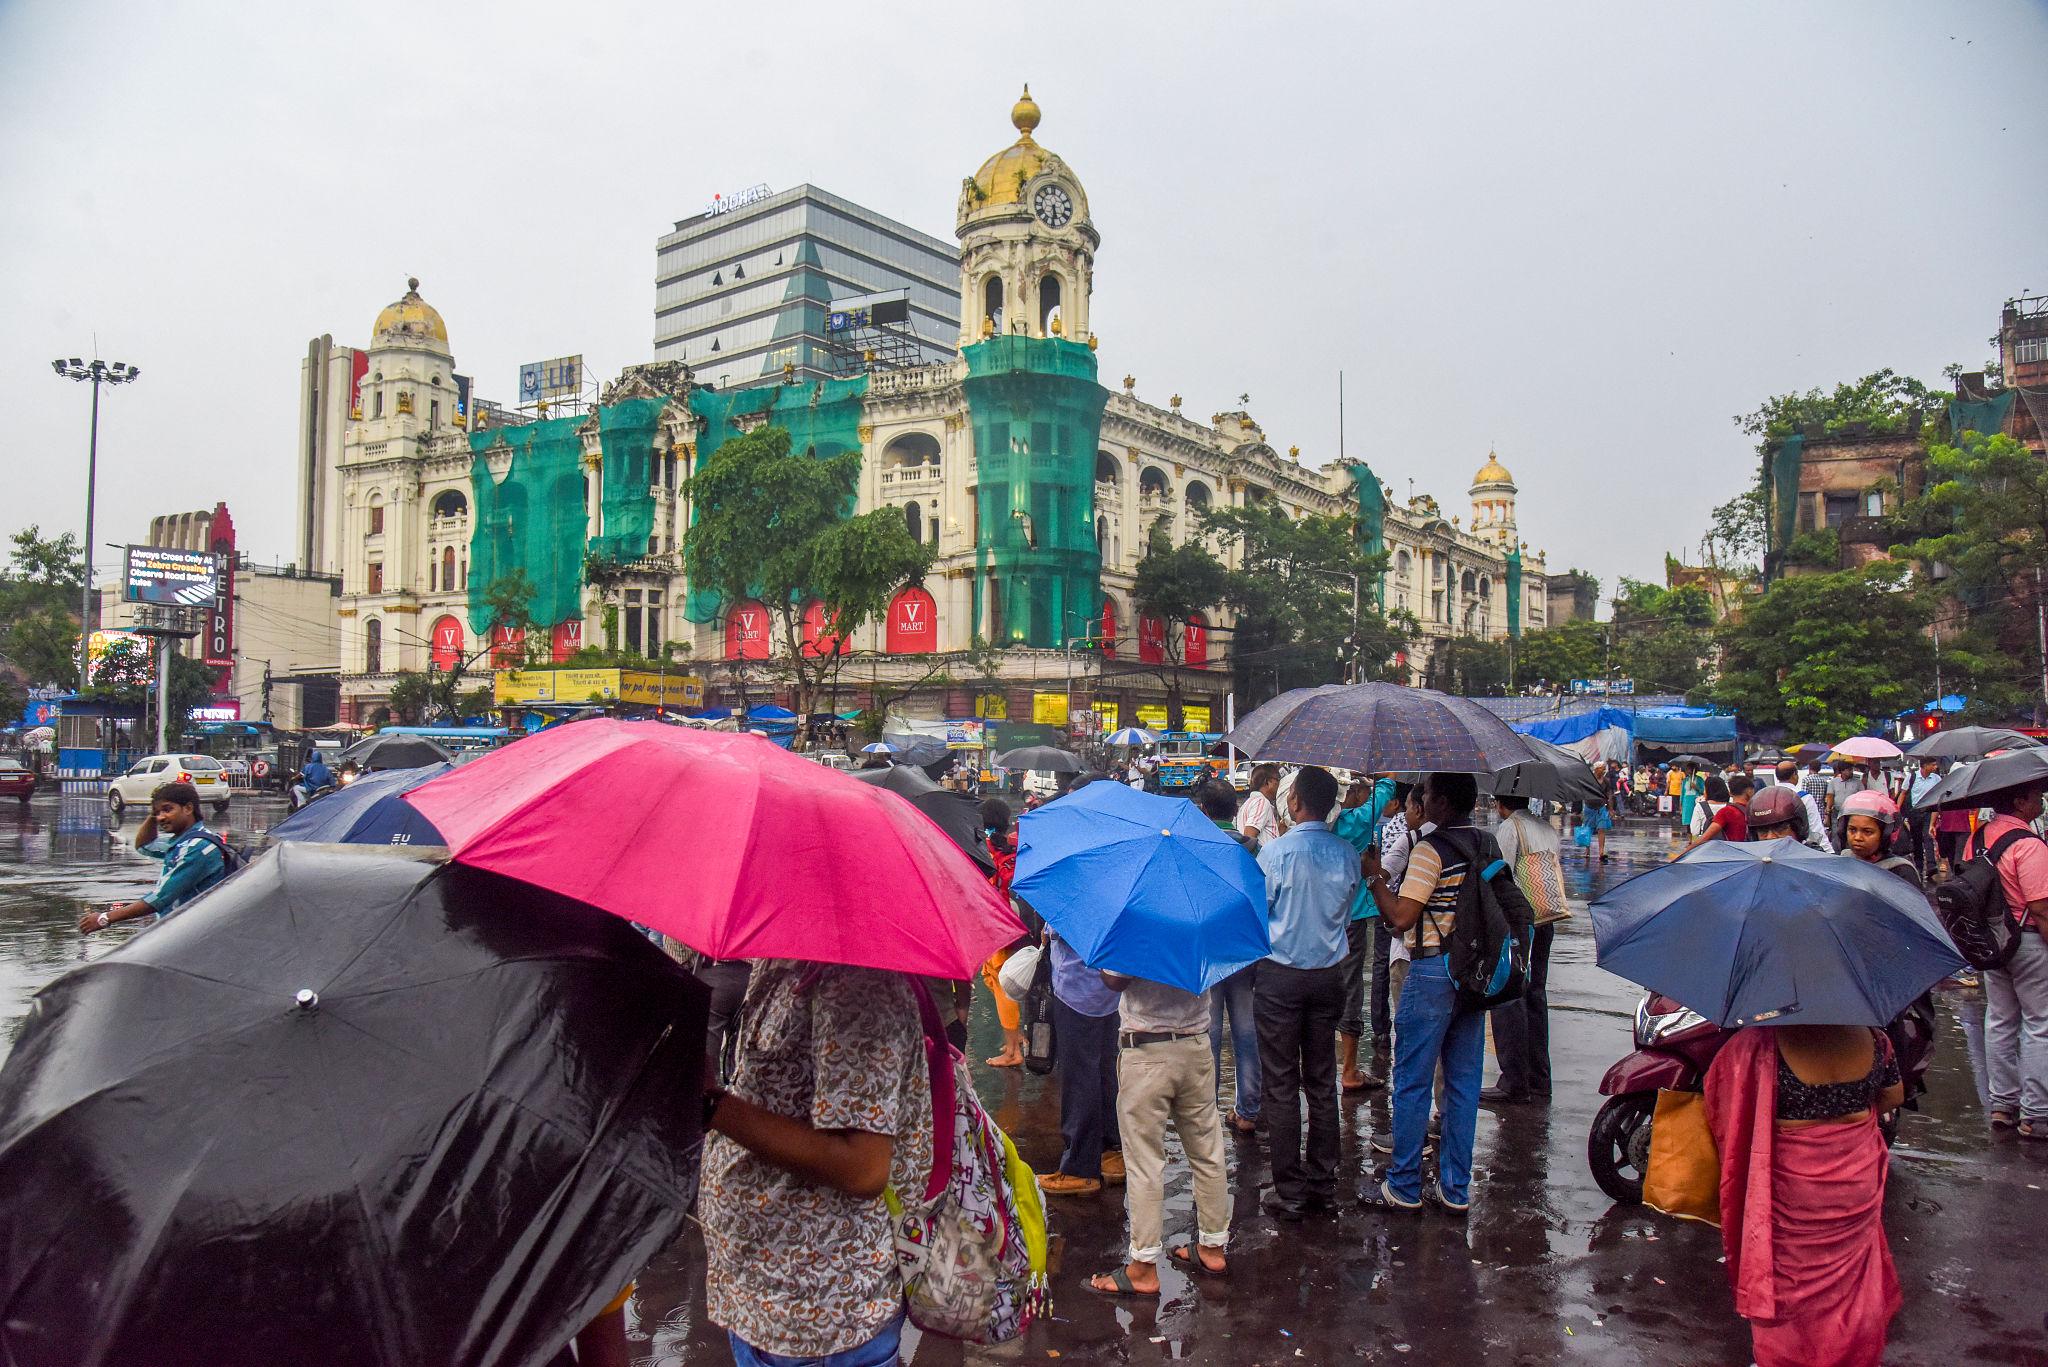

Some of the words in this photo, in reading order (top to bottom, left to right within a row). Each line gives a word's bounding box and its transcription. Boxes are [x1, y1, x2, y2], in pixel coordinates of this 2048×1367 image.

[549, 363, 576, 389] LIC
[131, 550, 160, 560] Always
[161, 552, 184, 561] Cross
[185, 554, 203, 565] Only
[204, 556, 213, 564] At
[131, 559, 147, 568] The
[147, 560, 171, 570] Zebra
[172, 563, 207, 574] Crossing
[129, 578, 152, 587] Rules
[130, 568, 164, 578] Observe
[165, 571, 186, 580] Road
[186, 573, 212, 585] Safety
[214, 553, 227, 653] METRO
[904, 603, 920, 622] V
[741, 613, 755, 631] V
[900, 621, 924, 632] MART
[444, 629, 455, 645] V
[504, 626, 514, 642] V
[567, 623, 579, 639] V
[1190, 626, 1198, 642] V
[391, 833, 411, 843] EU
